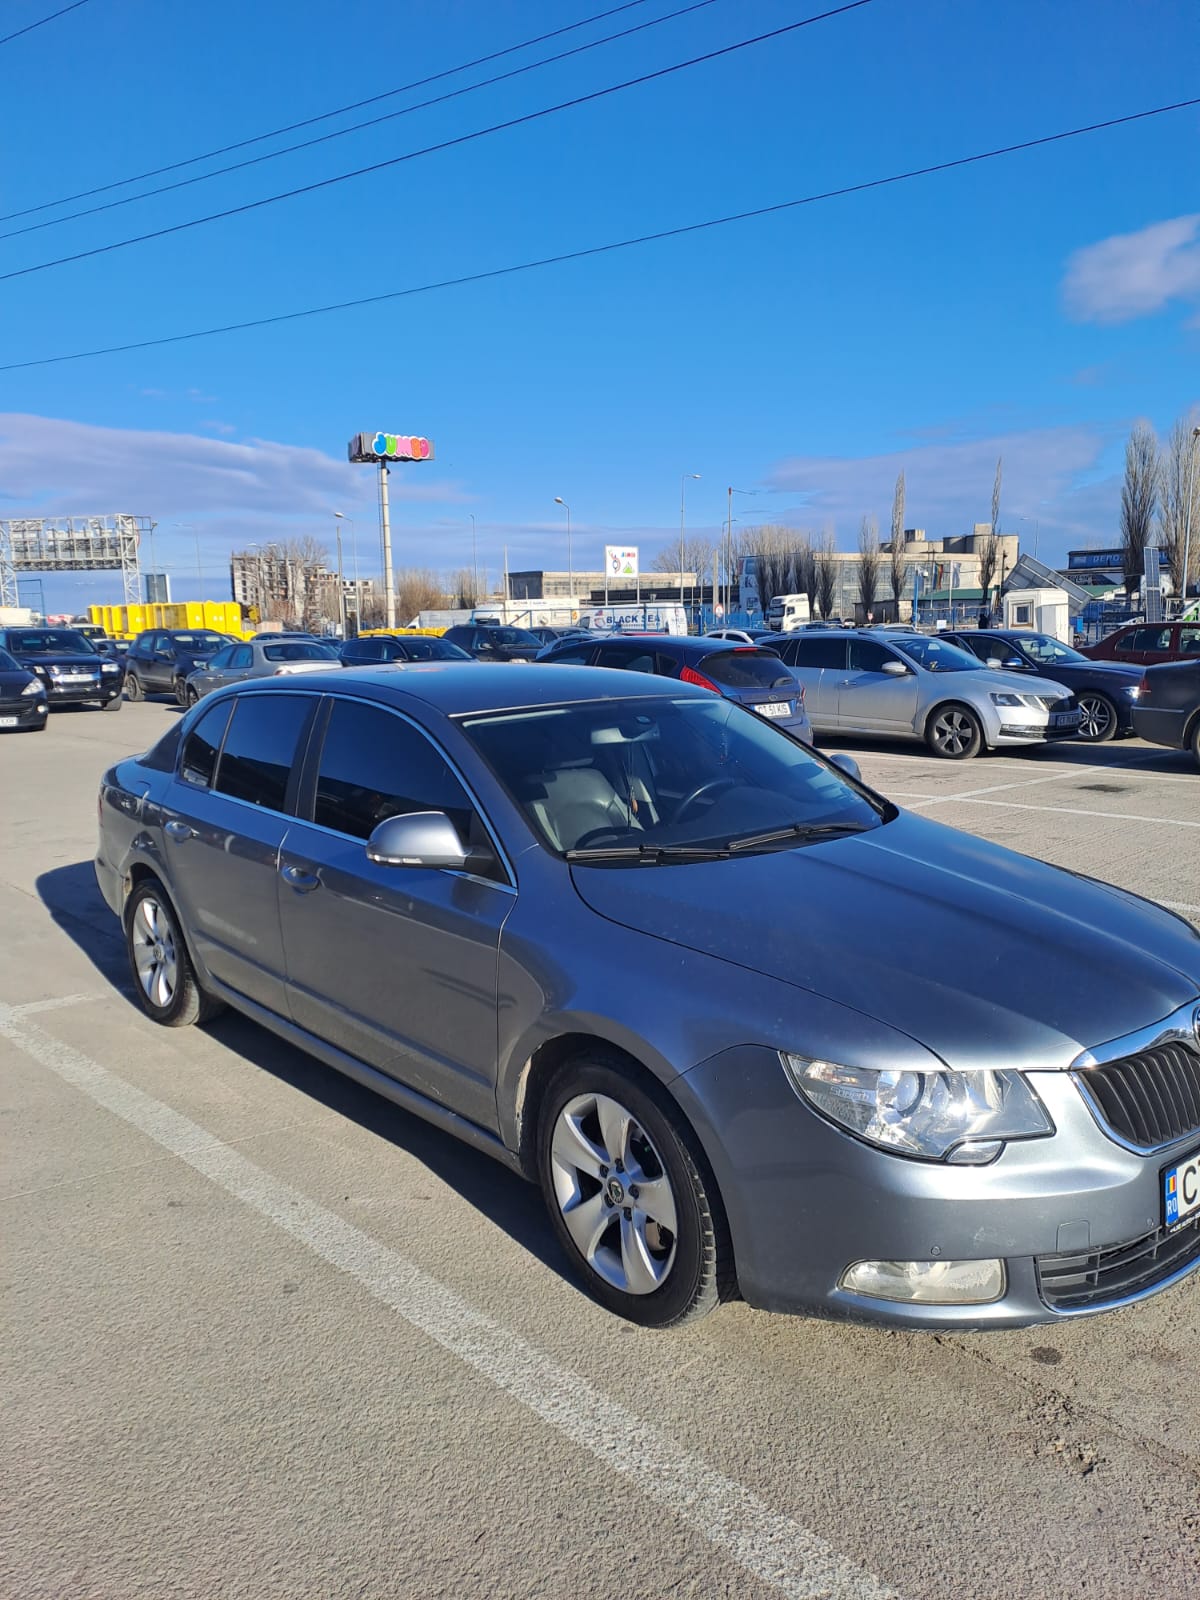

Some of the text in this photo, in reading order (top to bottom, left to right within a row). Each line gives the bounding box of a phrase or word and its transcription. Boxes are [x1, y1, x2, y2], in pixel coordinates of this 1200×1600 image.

[373, 433, 429, 459] JUMBO
[1092, 554, 1123, 563] DEPO
[606, 614, 660, 624] BLACK SEA
[1183, 1160, 1200, 1205] C
[1167, 1197, 1178, 1215] RO
